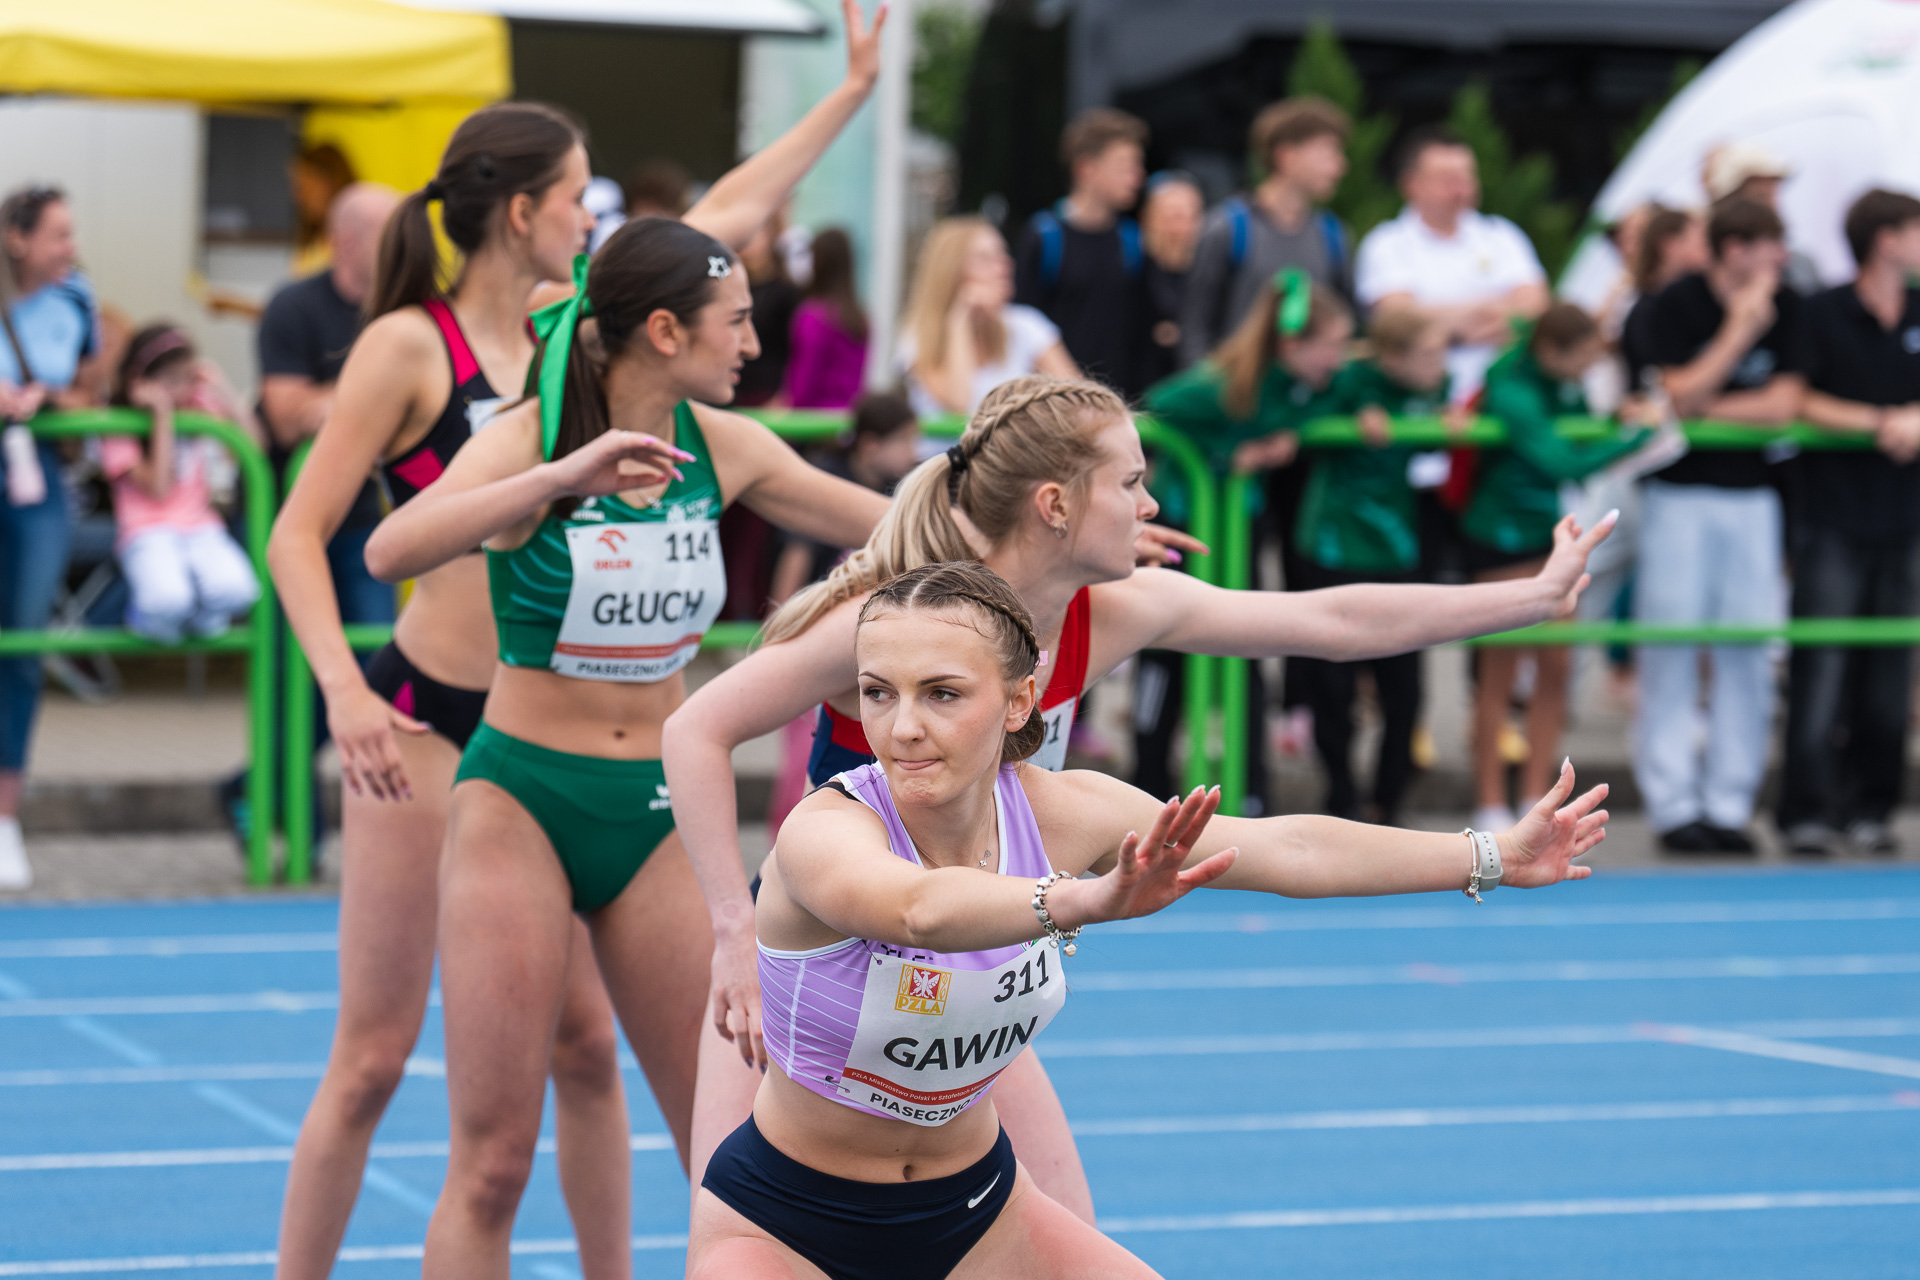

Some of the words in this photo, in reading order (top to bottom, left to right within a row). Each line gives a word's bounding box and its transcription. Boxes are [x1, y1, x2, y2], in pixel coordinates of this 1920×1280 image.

[665, 531, 710, 562] 114
[592, 588, 705, 626] GŁUCH
[993, 949, 1050, 1003] 311
[897, 996, 941, 1014] PZLA
[883, 1015, 1039, 1072] GAWIN
[851, 1071, 868, 1080] PZLA
[909, 1093, 930, 1102] Polski
[869, 1092, 971, 1122] PIASECZNO
